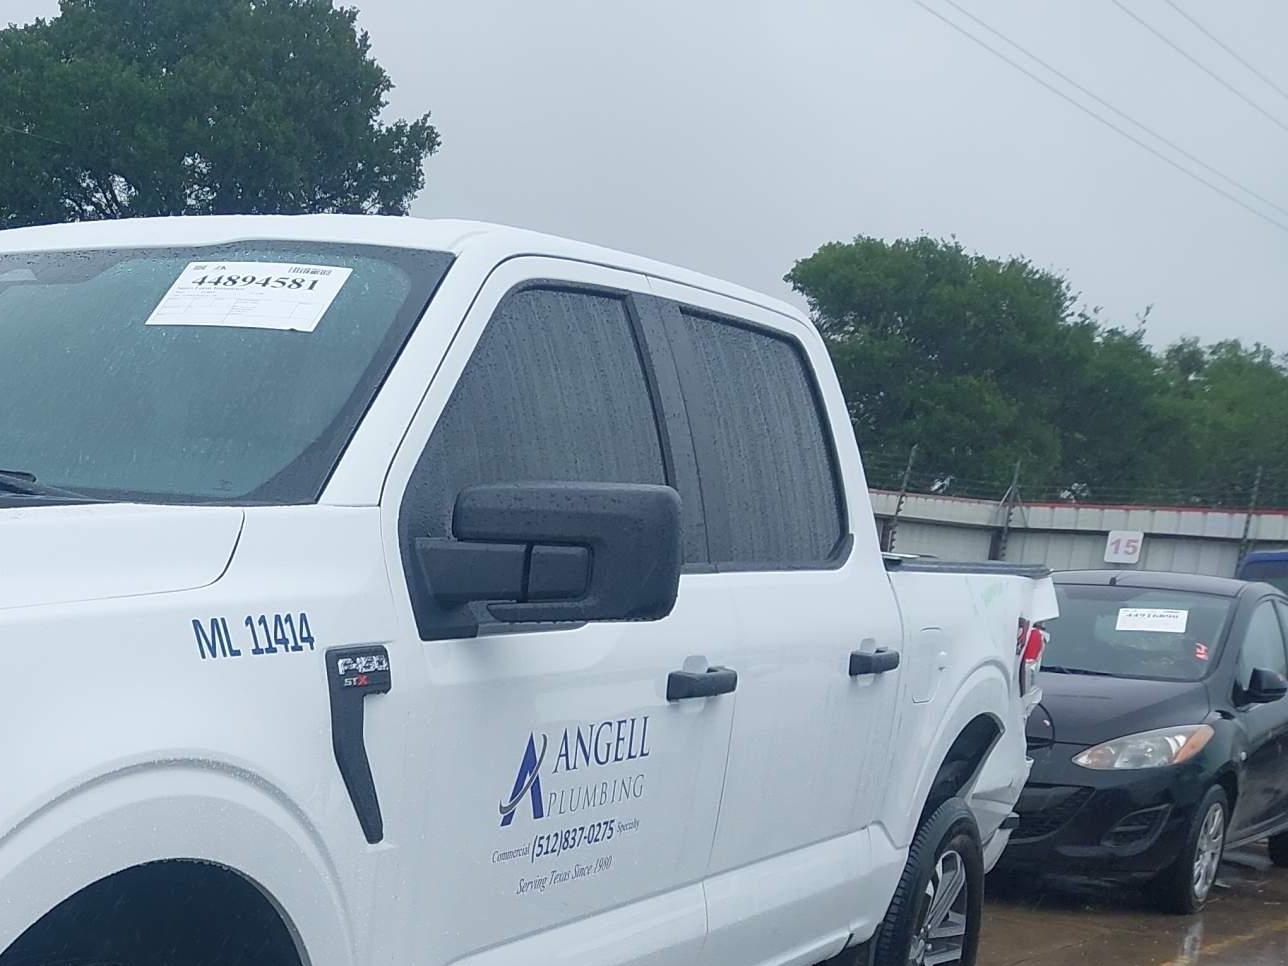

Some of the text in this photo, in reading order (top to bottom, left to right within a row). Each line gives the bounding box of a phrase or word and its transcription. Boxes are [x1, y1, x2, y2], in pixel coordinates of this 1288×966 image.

[192, 274, 320, 291] 44894581
[1110, 539, 1139, 555] 15
[192, 612, 315, 660] ML 11414
[344, 674, 369, 686] STX
[552, 716, 651, 773] ANGELL
[547, 774, 645, 817] PLUMBING
[492, 843, 530, 864] Commercial
[531, 819, 616, 863] (512)837-0275
[517, 875, 547, 895] Serving
[549, 870, 571, 886] Texas
[572, 864, 593, 880] Since
